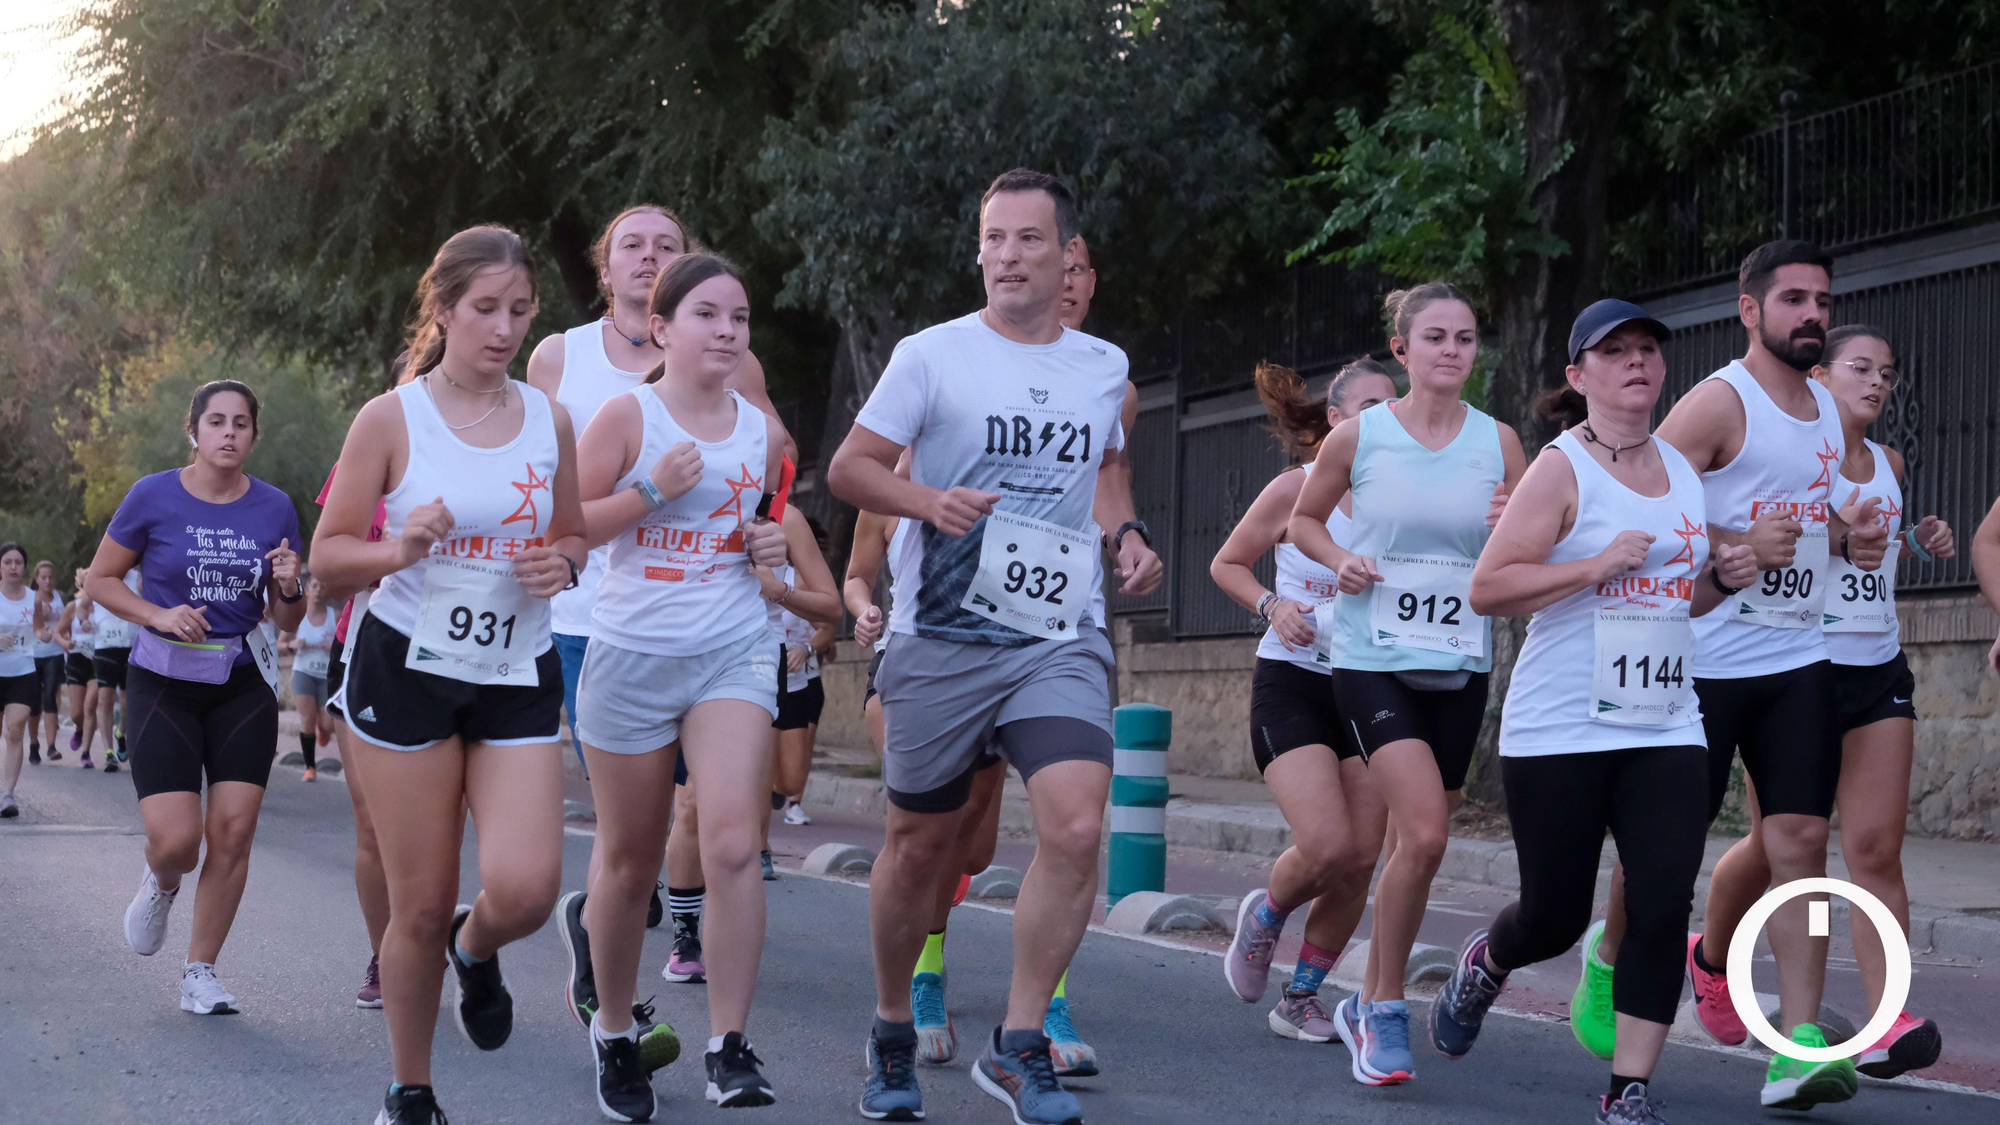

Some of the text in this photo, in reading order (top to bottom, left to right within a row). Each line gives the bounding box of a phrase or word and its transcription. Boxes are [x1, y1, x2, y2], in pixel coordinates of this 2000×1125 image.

[1029, 387, 1049, 397] Rock
[985, 414, 1091, 463] NR 21
[185, 525, 235, 537] Si dejas salir
[993, 515, 1009, 524] XVII
[1010, 518, 1044, 532] CARRERA
[1062, 532, 1080, 543] MUJER
[1080, 537, 1092, 546] 2022
[193, 533, 214, 548] Tus
[186, 548, 218, 557] tendrás
[199, 557, 252, 567] espacio para
[435, 558, 453, 566] XVII
[454, 561, 493, 575] CARRERA
[494, 568, 505, 577] DE
[654, 568, 684, 577] IMDECO
[1397, 557, 1428, 565] CARRERA
[1451, 561, 1471, 569] MUJER
[186, 564, 223, 586] Vivir
[226, 576, 247, 587] Tus
[1003, 560, 1068, 605] 932
[1761, 568, 1814, 598] 990
[190, 583, 238, 602] sueños
[1840, 573, 1887, 602] 390
[1397, 592, 1462, 626] 912
[1616, 614, 1652, 622] CARRERA
[448, 606, 516, 649] 931
[1612, 654, 1684, 689] 1144
[1640, 703, 1665, 712] IMDECO
